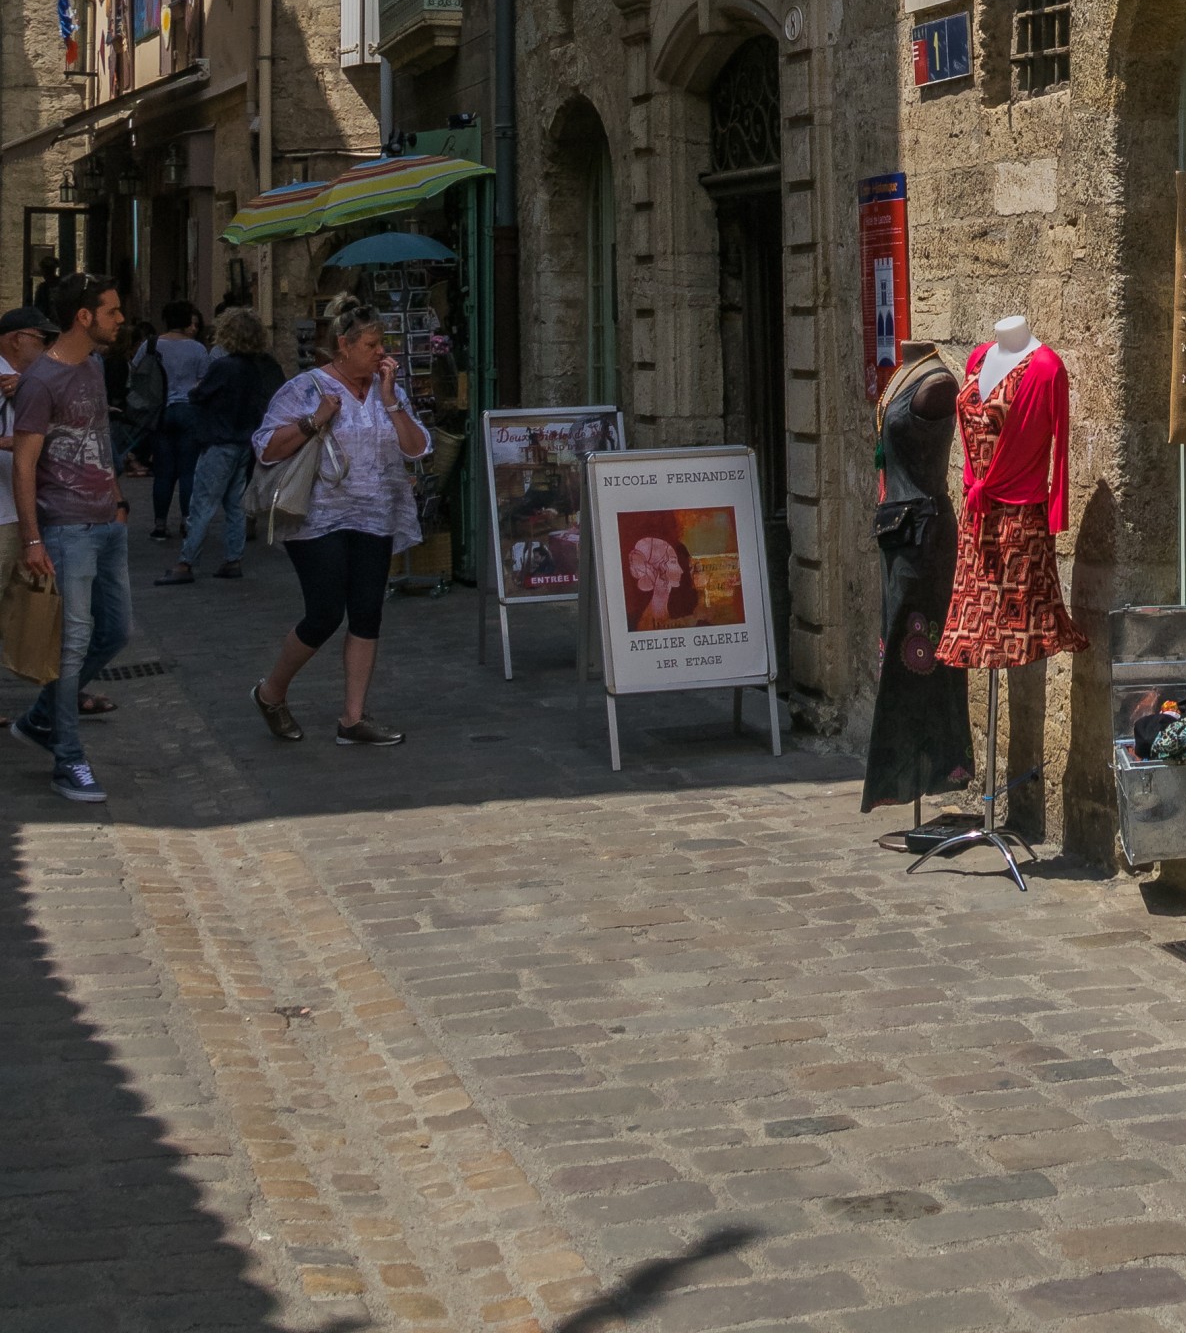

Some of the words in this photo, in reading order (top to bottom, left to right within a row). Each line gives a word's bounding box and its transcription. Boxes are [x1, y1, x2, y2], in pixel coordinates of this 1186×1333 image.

[496, 426, 530, 444] Deux
[603, 474, 658, 487] NICOLE
[666, 469, 746, 484] FERNANDEZ
[630, 636, 687, 652] ATELIER
[693, 631, 749, 647] GALERIE
[656, 658, 679, 670] 1ER
[685, 655, 723, 668] ETAGE
